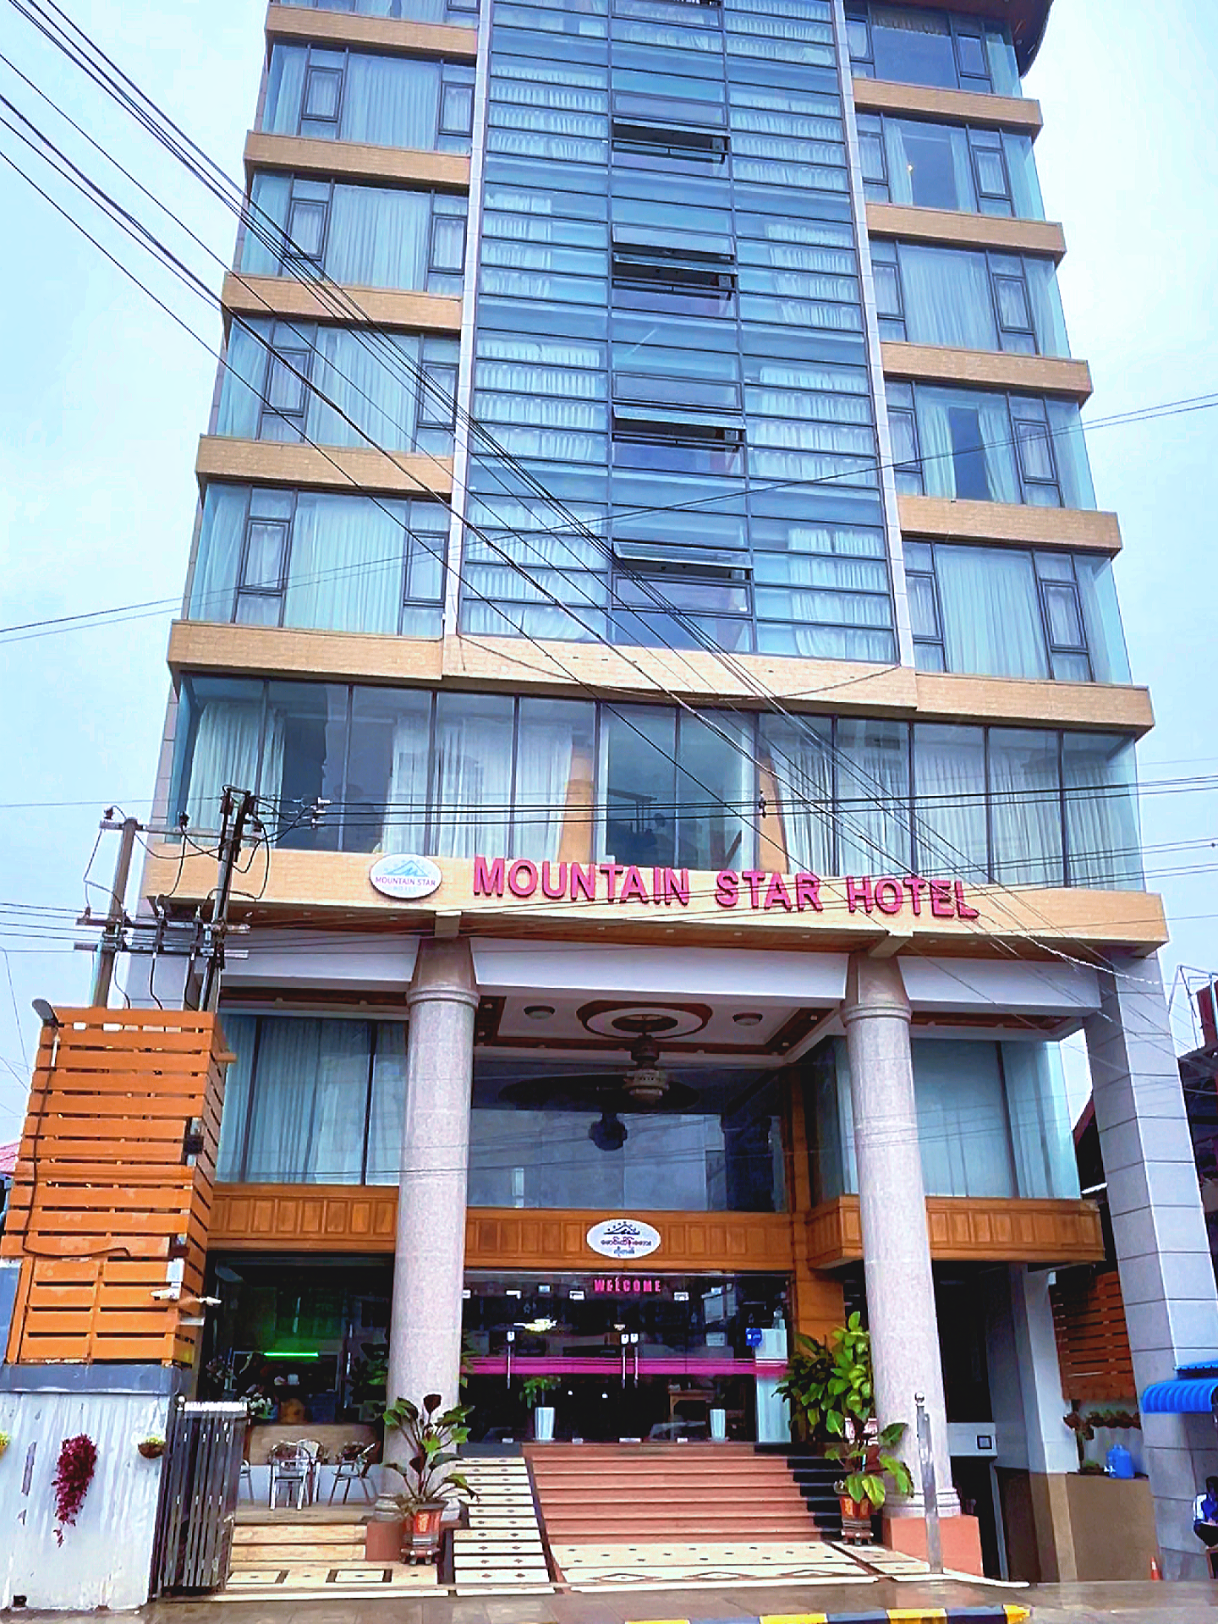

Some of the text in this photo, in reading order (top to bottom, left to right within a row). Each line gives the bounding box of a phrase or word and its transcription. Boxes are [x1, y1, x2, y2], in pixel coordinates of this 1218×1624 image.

[375, 876, 415, 885] MOUNTAIN
[473, 856, 980, 919] MOUNTAIN STAR HOTEL
[593, 1279, 661, 1292] WELCOME
